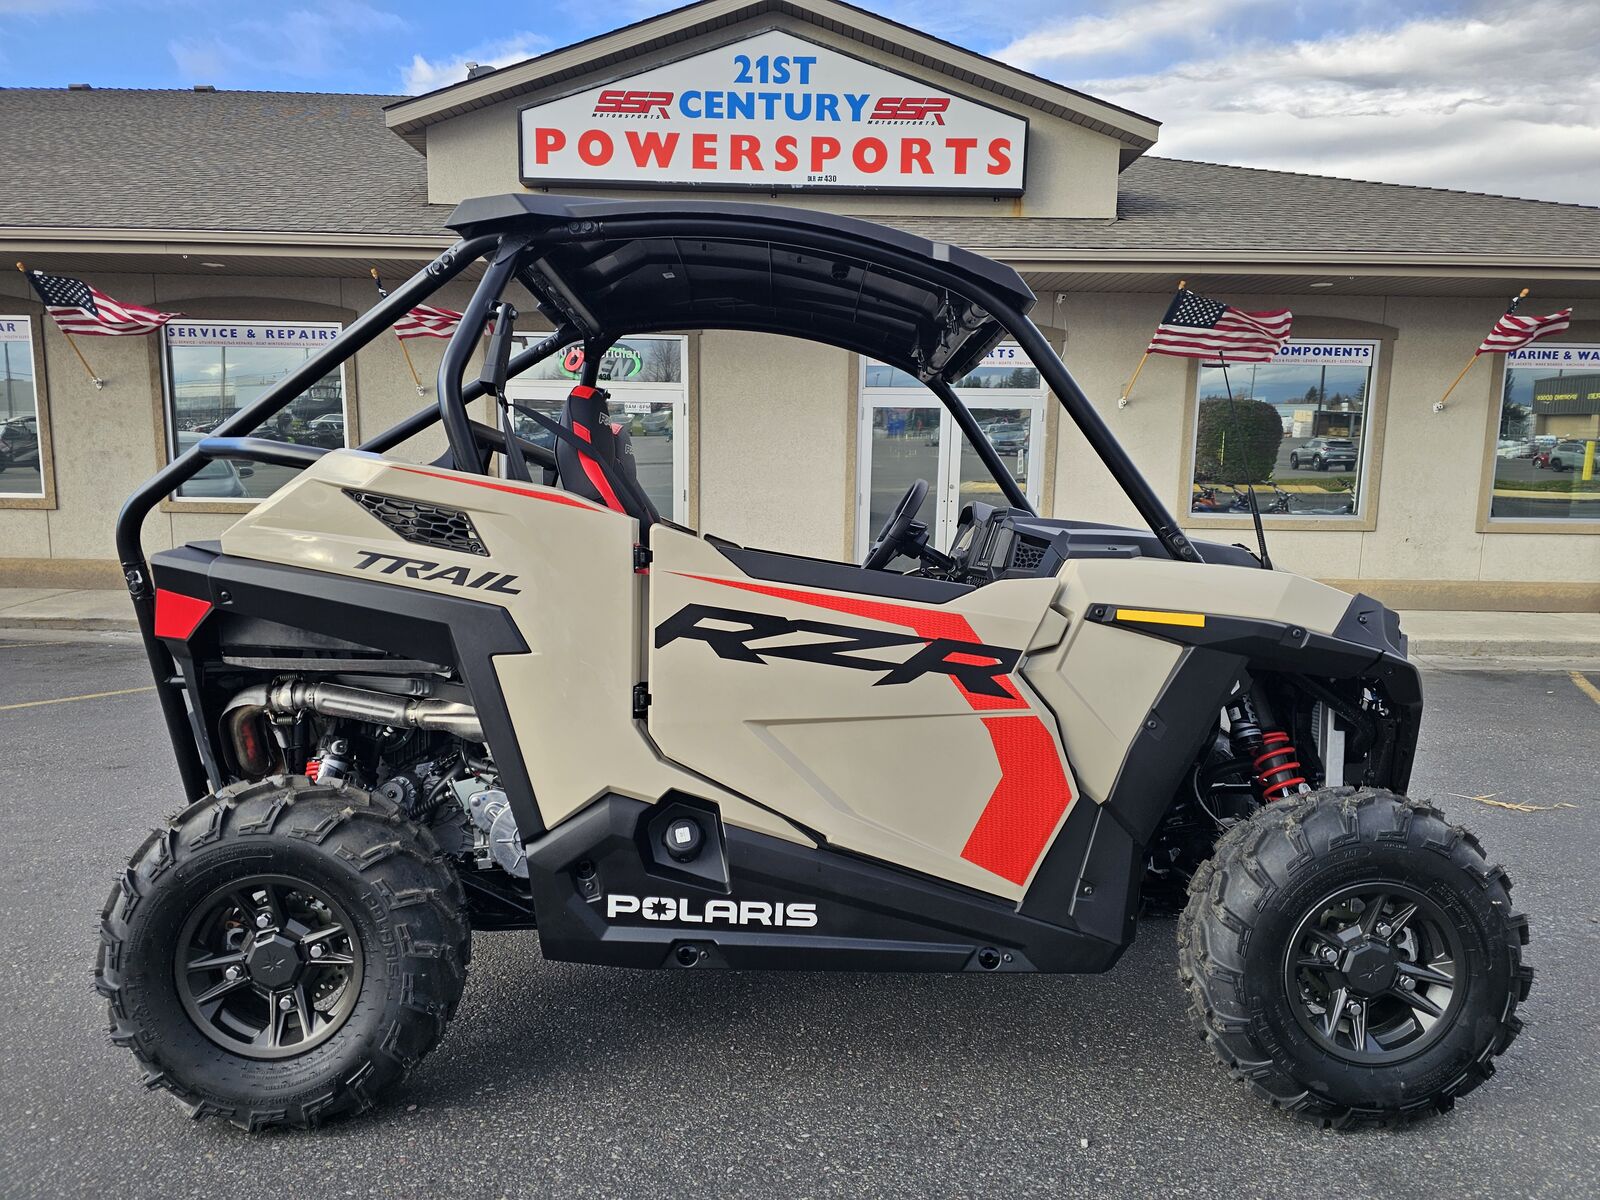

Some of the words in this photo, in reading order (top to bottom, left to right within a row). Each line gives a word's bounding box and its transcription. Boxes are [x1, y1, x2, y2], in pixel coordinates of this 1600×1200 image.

[733, 54, 817, 85] 21ST
[594, 90, 675, 119] SSR
[679, 90, 871, 122] CENTURY
[869, 96, 951, 126] SSR
[535, 127, 1012, 175] POWERSPORTS
[168, 327, 238, 338] SERVICE
[247, 329, 256, 339] &
[265, 329, 337, 340] REPAIRS
[1275, 346, 1369, 357] OMPONENTS
[1508, 350, 1559, 360] MARINE
[1563, 350, 1572, 360] &
[353, 550, 522, 595] TRAIL
[655, 603, 1023, 700] RZR
[607, 893, 818, 927] POLARIS
